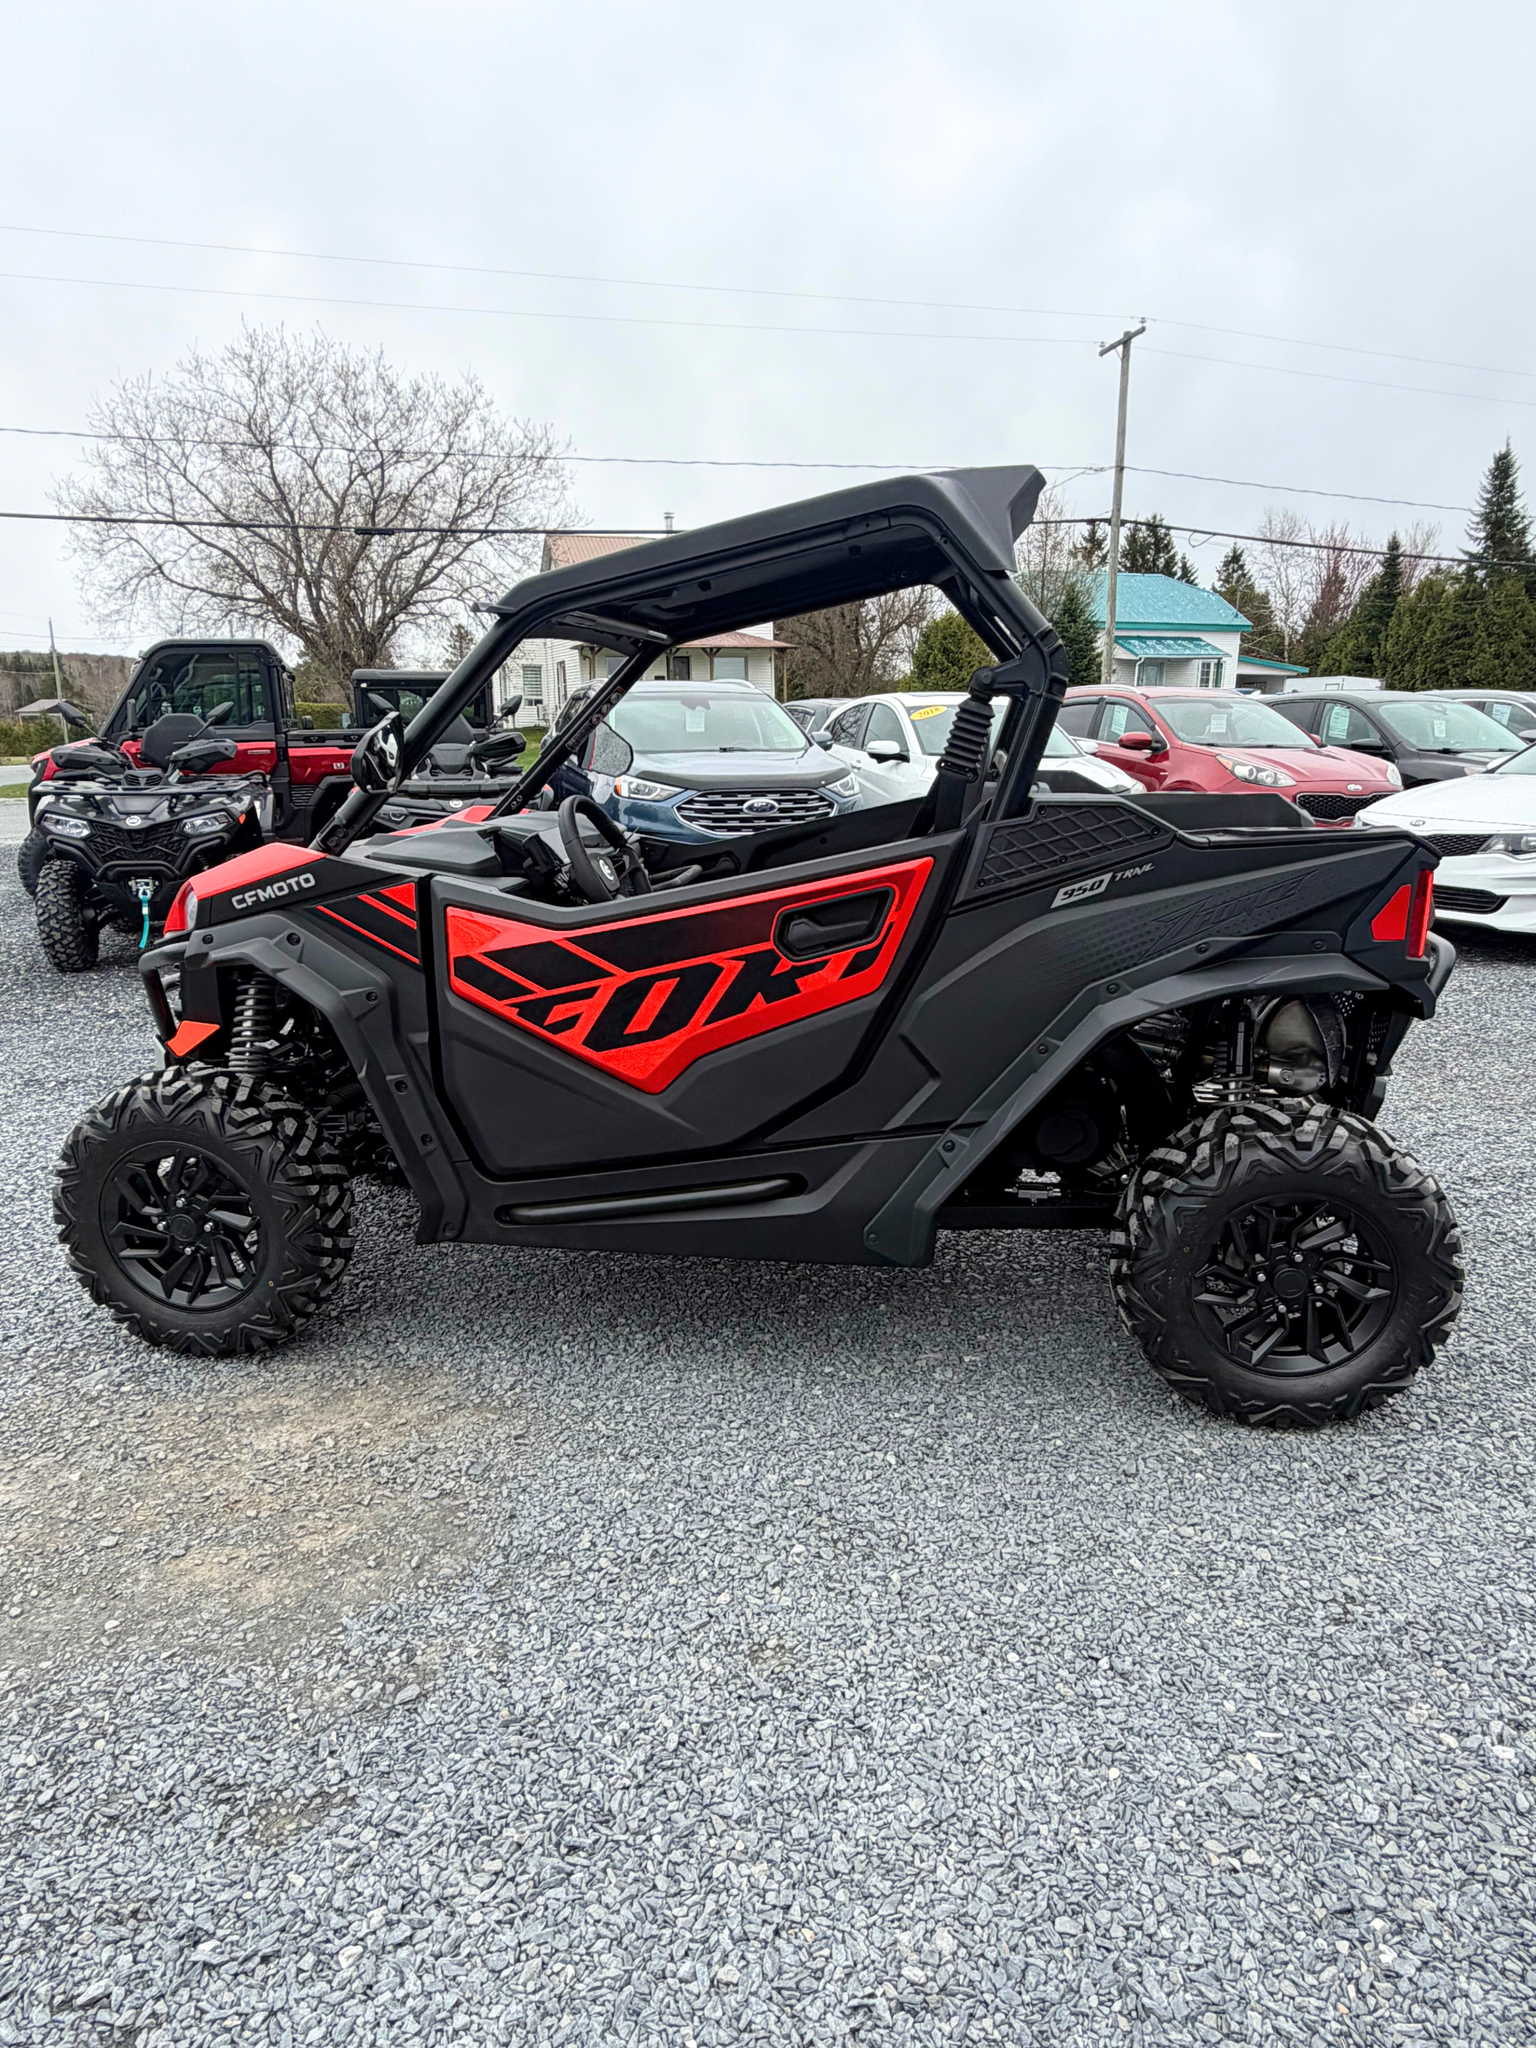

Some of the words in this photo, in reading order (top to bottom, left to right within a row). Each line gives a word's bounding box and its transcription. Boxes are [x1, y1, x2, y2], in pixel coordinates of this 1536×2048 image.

[231, 872, 316, 910] CFMOTO
[1060, 879, 1105, 901] 950
[1114, 862, 1156, 881] TRAIL
